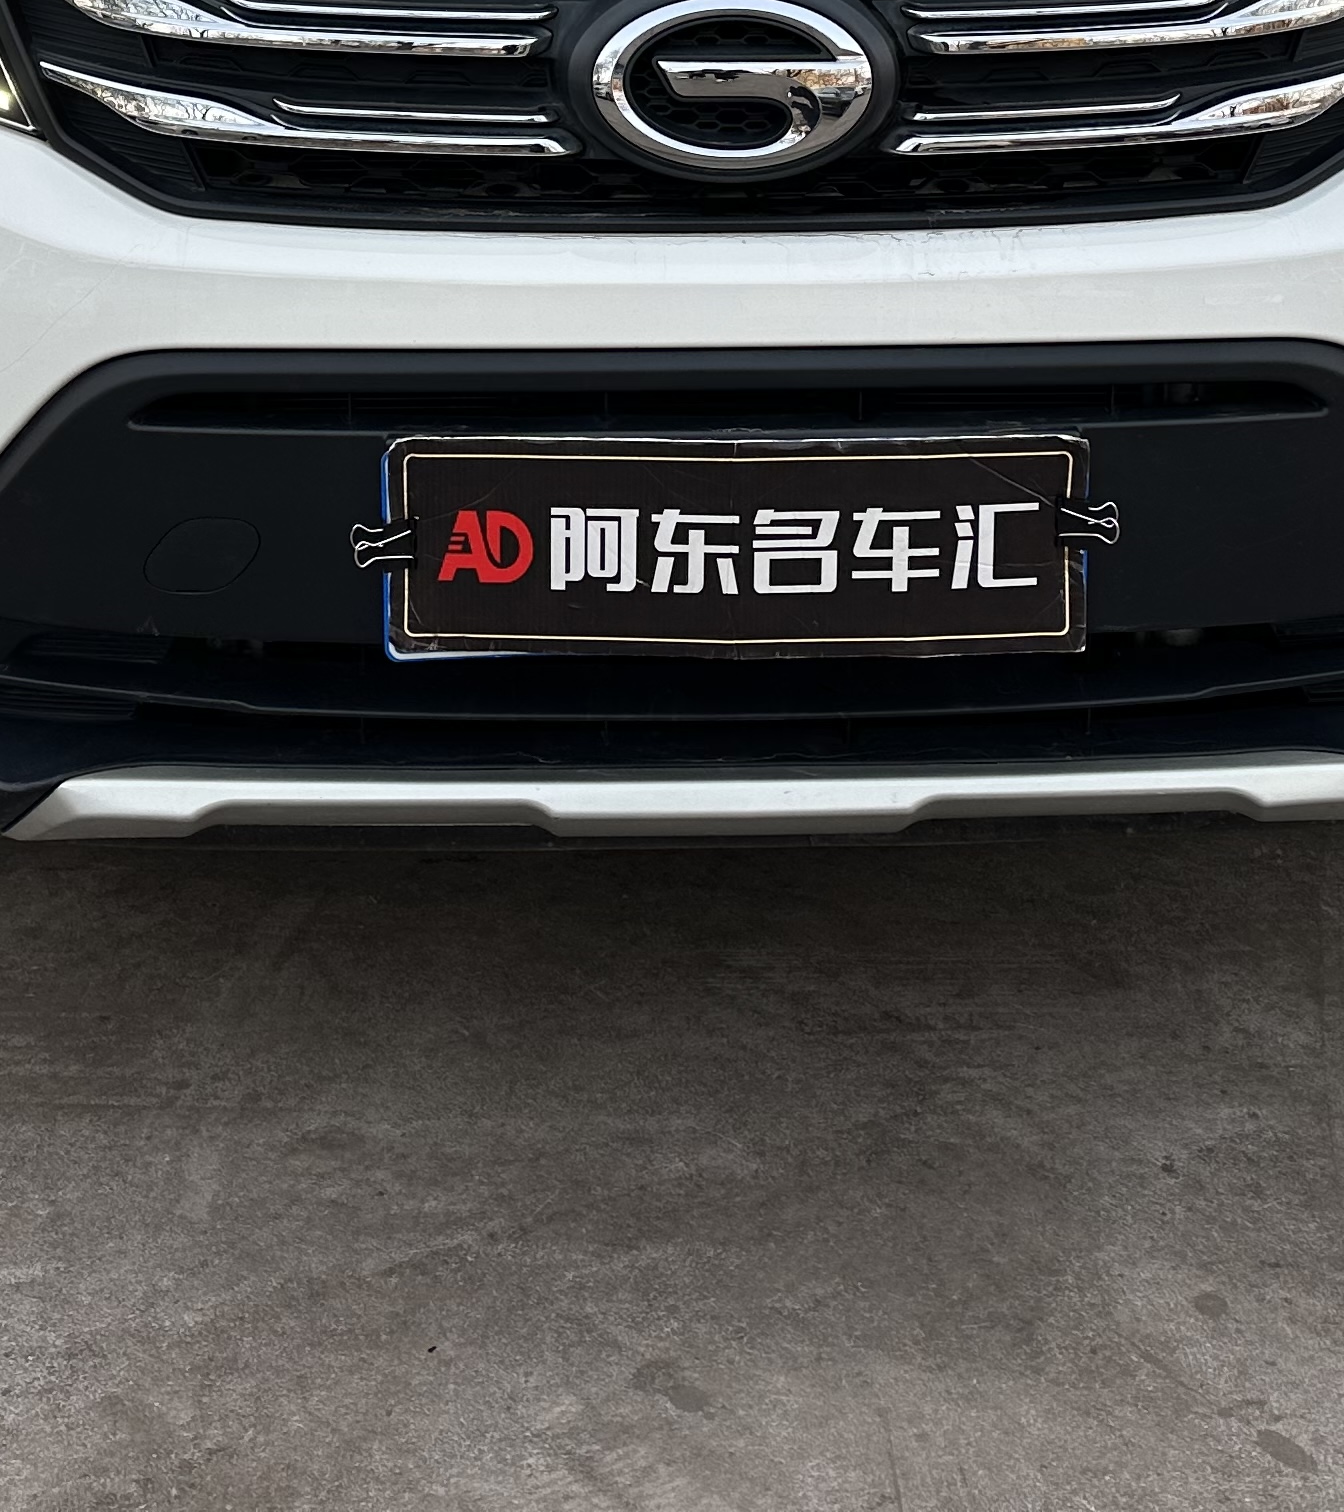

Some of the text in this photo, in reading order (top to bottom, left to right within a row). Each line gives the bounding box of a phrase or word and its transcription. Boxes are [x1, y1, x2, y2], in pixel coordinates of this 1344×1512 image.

[438, 503, 1040, 595] AD 阿东名车汇
